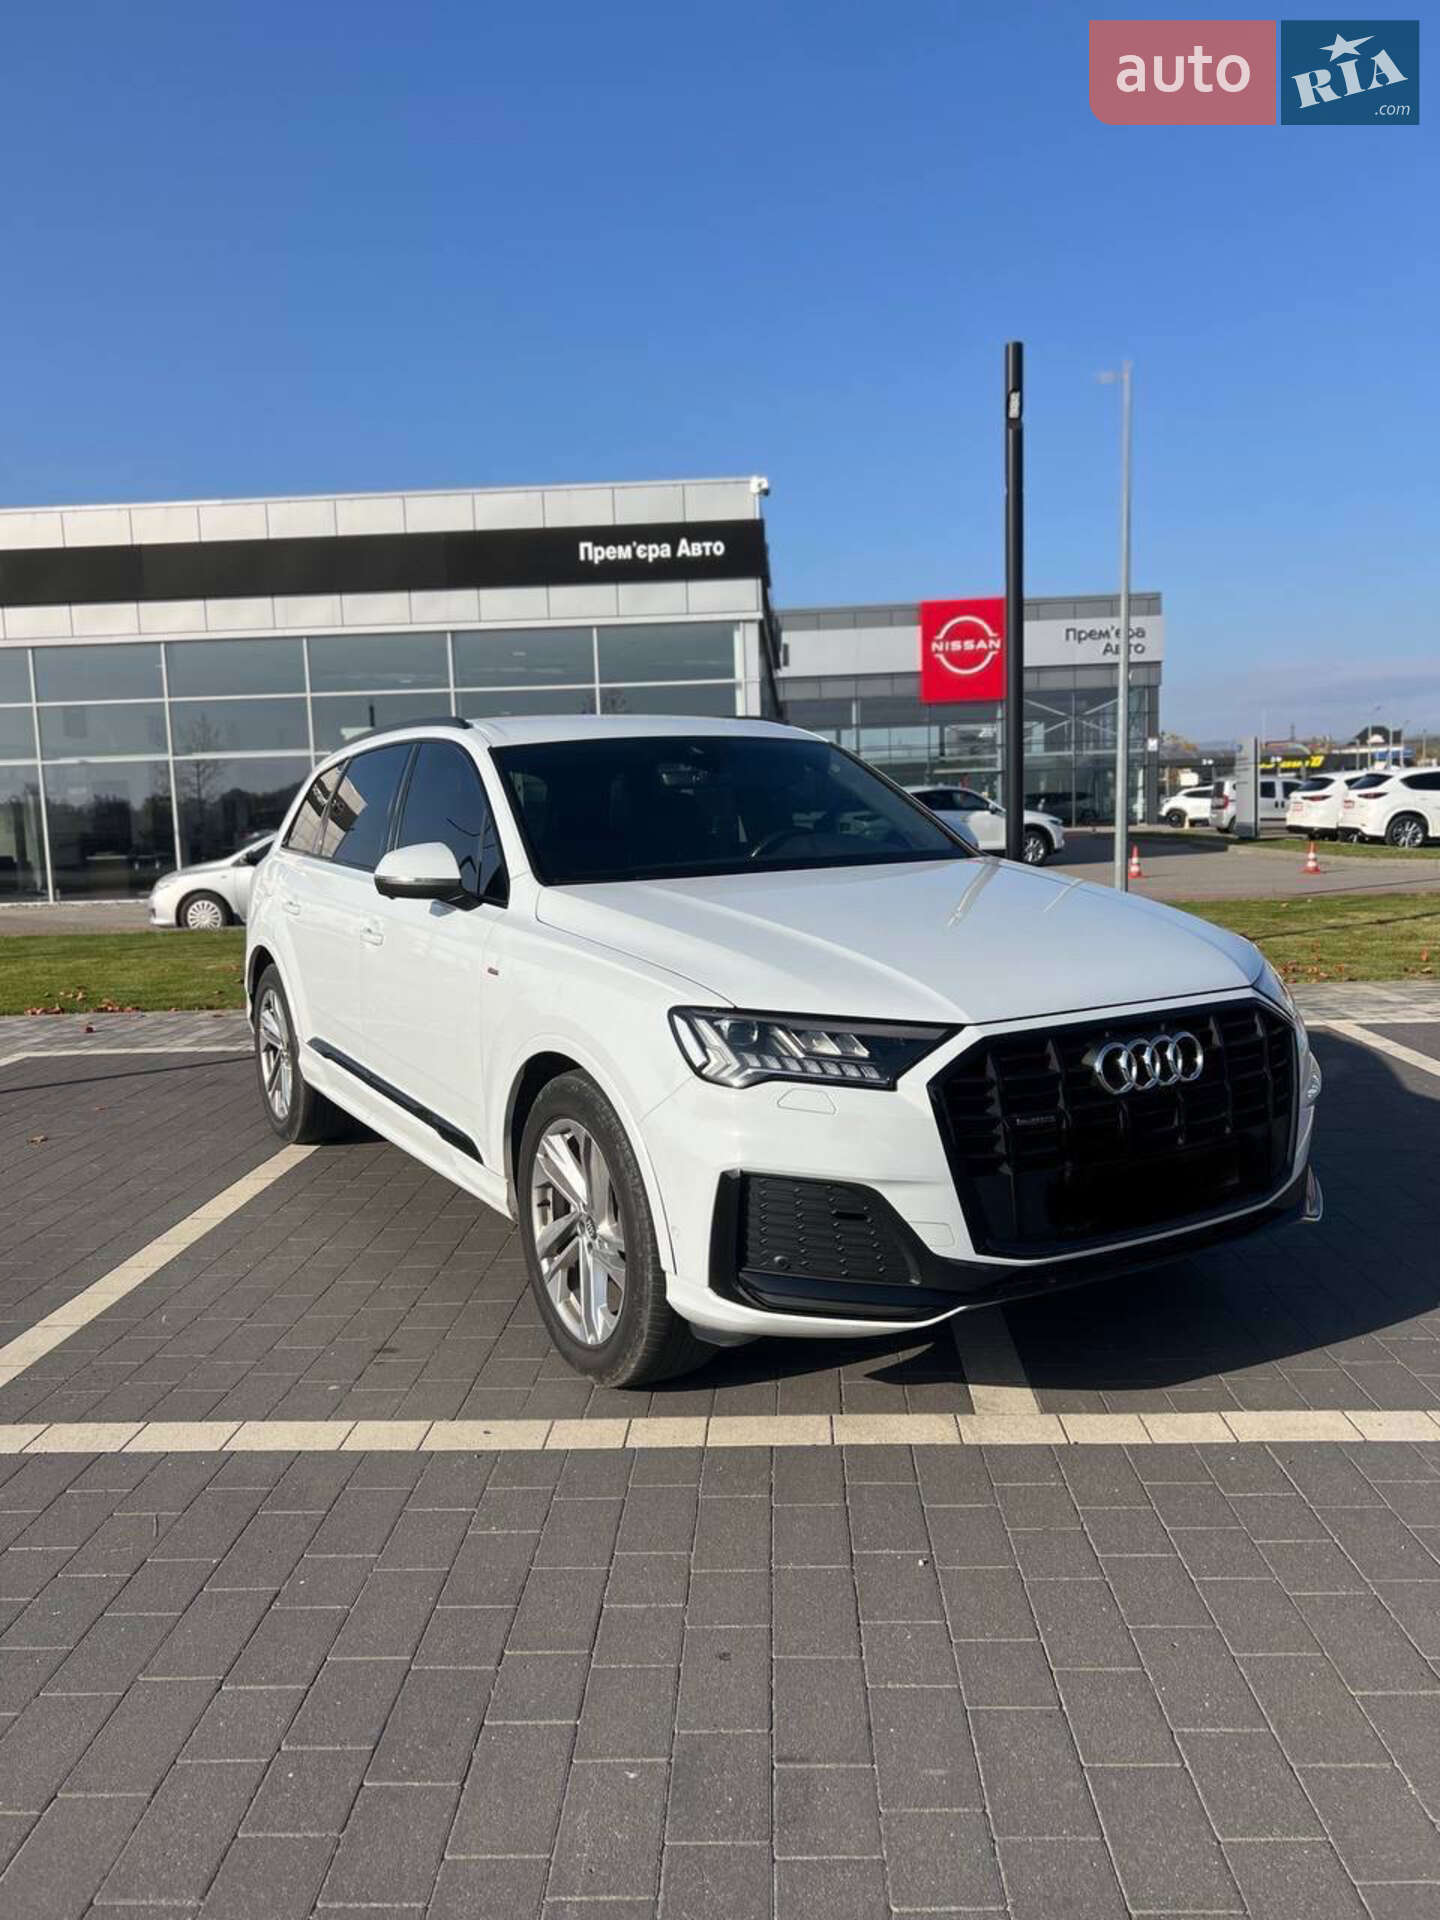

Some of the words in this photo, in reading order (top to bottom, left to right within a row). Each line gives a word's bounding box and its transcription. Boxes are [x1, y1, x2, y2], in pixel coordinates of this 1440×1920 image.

[578, 540, 672, 565] Прем'єра
[676, 537, 725, 558] Авто
[932, 638, 1001, 652] NISSAN
